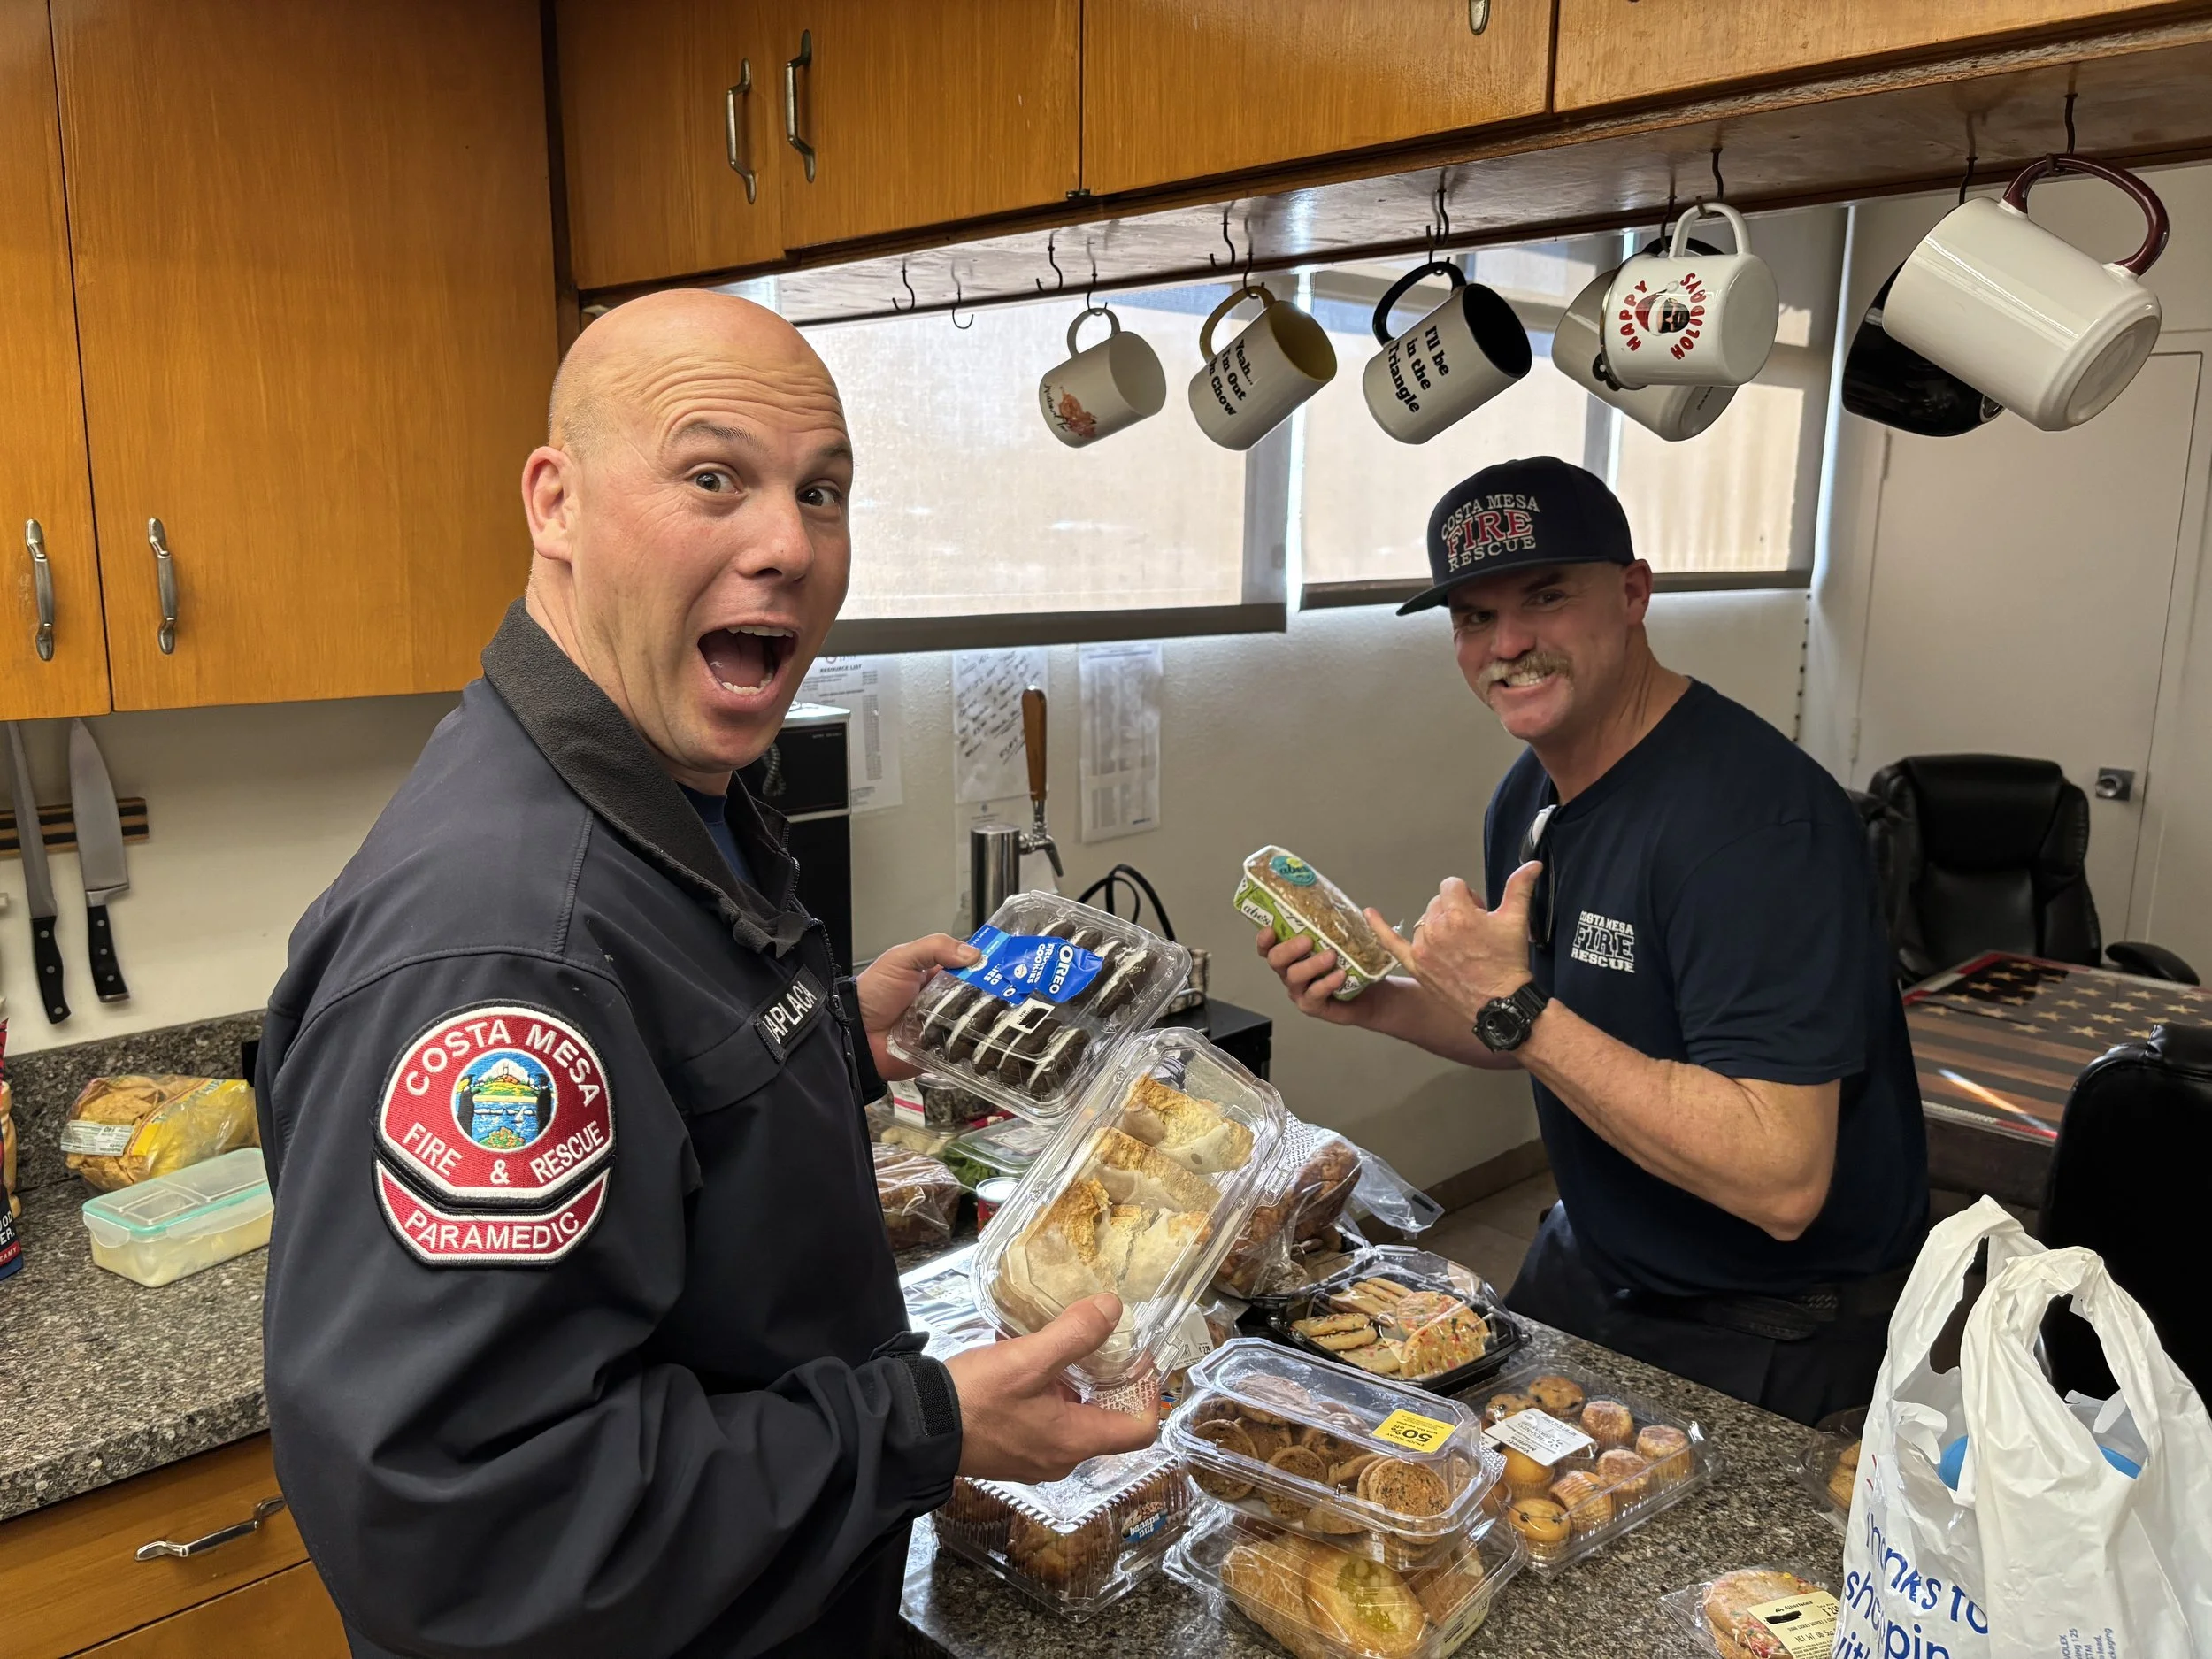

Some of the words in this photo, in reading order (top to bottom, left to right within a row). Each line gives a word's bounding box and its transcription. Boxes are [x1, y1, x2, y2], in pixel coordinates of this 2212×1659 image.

[1619, 280, 1647, 351] HAPPY
[1671, 273, 1707, 360] HOLIDAYS
[1406, 337, 1417, 359] in
[1425, 325, 1440, 352] I'll
[1236, 338, 1253, 386] Yeah...
[1388, 341, 1420, 413] Triangle
[1411, 358, 1432, 390] the
[1432, 349, 1449, 376] be
[1211, 376, 1237, 416] Chow
[1227, 372, 1247, 401] Out
[1440, 498, 1485, 541] COSTA
[1486, 494, 1540, 513] MESA
[1446, 509, 1534, 558] FIRE
[1448, 535, 1537, 573] RESCUE
[1243, 904, 1271, 928] abe's
[1606, 917, 1634, 936] MESA
[1571, 947, 1635, 973] RESCUE
[1573, 921, 1635, 963] FIRE
[1026, 943, 1046, 984] COOKIES
[1048, 944, 1074, 995] OREO
[405, 1018, 512, 1096] COSTA
[525, 1023, 601, 1107] MESA
[402, 1121, 464, 1177] FIRE
[489, 1159, 511, 1185] &
[529, 1120, 605, 1184] RESCUE
[403, 1209, 580, 1250] PARAMEDIC
[1506, 1438, 1530, 1454] Variety
[1129, 1512, 1161, 1537] banana
[1139, 1523, 1155, 1539] nut
